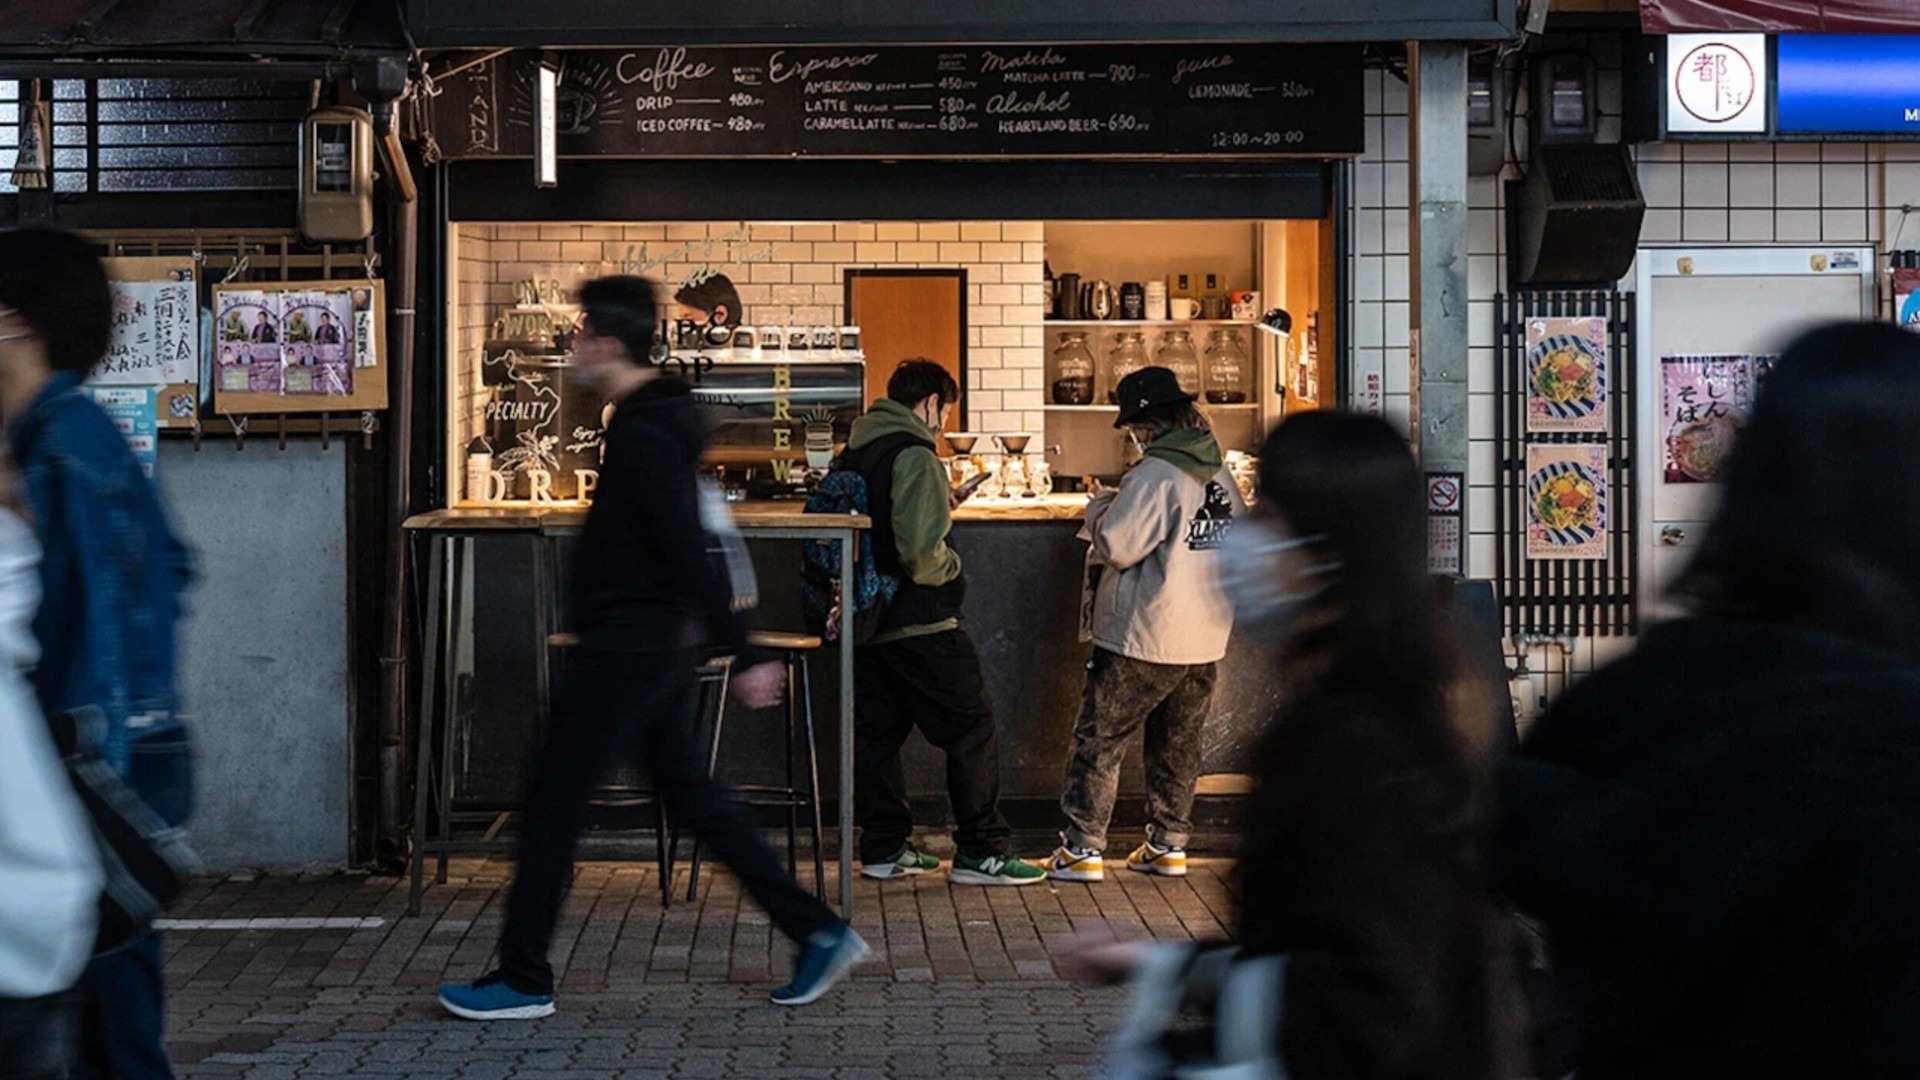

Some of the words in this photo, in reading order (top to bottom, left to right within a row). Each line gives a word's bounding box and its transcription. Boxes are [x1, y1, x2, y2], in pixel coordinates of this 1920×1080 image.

[616, 47, 716, 92] Coffee
[980, 47, 1068, 73] Matcha
[1003, 71, 1051, 83] MATCHA
[1052, 70, 1086, 82] LATTE
[1107, 64, 1136, 82] 700
[804, 80, 873, 95] AMERICANO
[1188, 82, 1254, 99] LEMONADE
[636, 95, 673, 111] DRIP
[728, 92, 752, 107] 480
[804, 99, 848, 112] LATTE
[938, 96, 965, 113] 580
[985, 90, 1073, 115] Alcohol
[637, 119, 666, 133] ICED
[667, 118, 712, 132] COFFEE
[939, 115, 967, 132] 680
[998, 119, 1067, 134] HEARTLAND
[1068, 118, 1099, 132] BEER
[508, 314, 574, 337] WORLD
[1703, 361, 1729, 418] にしん
[486, 401, 550, 421] PECIALTY
[1677, 385, 1699, 422] そば
[770, 365, 796, 482] BREW
